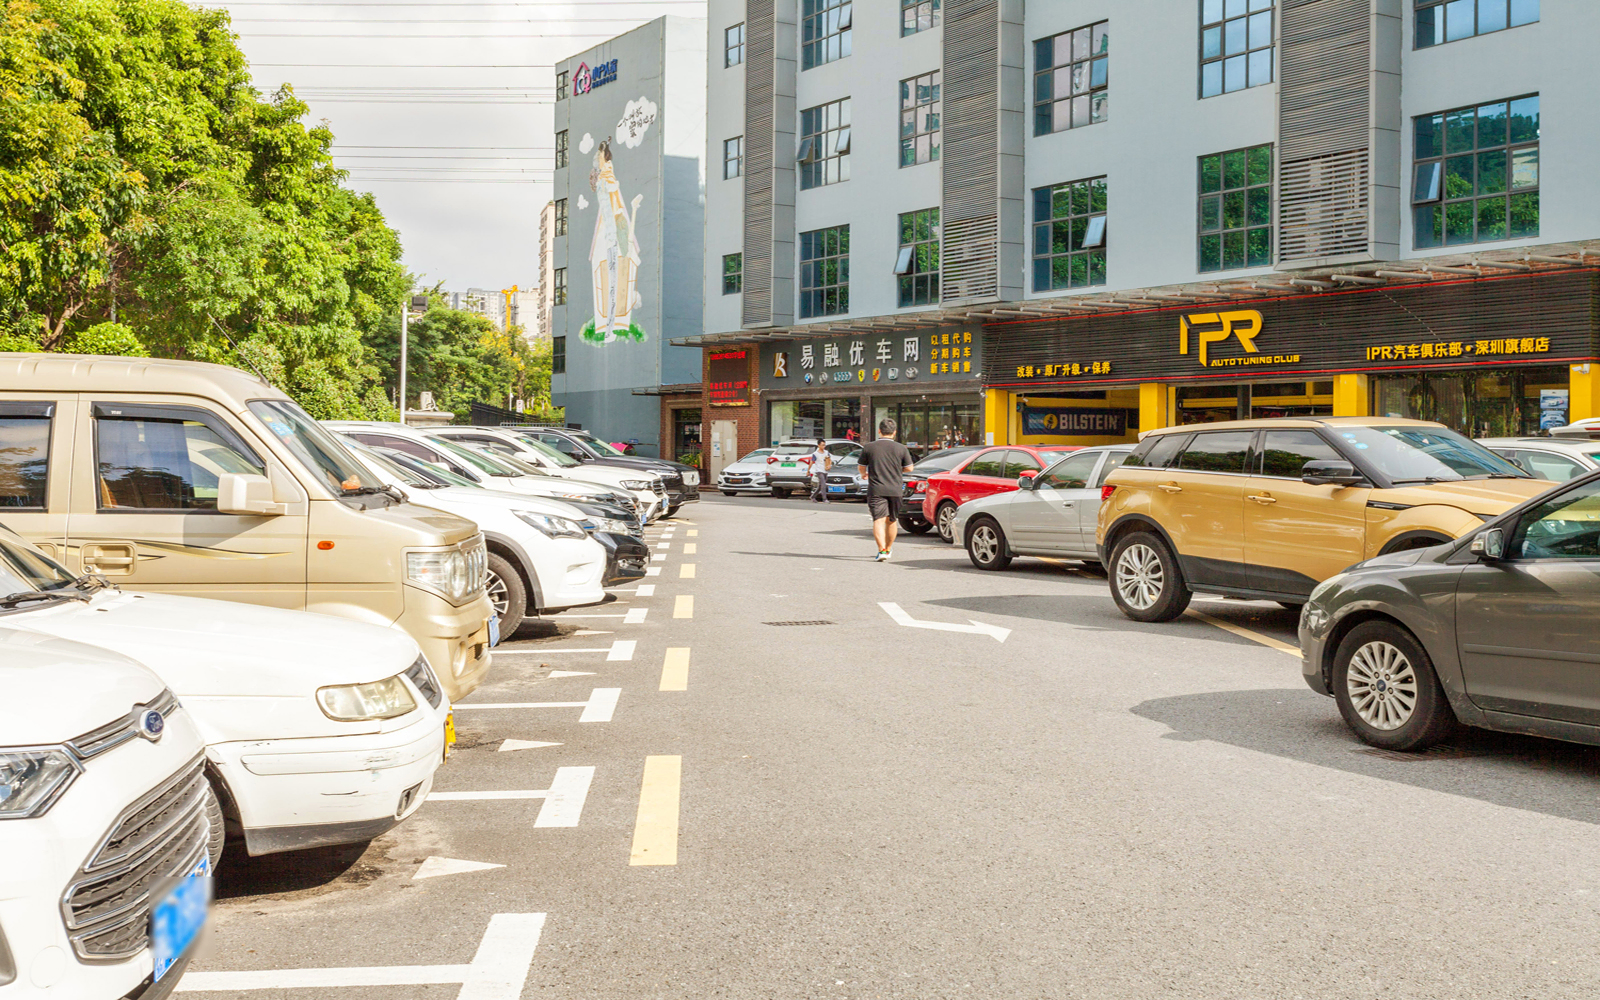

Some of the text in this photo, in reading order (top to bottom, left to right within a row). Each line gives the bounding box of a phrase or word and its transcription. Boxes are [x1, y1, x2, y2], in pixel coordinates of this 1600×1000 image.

[930, 332, 972, 346] 以租代购
[801, 337, 919, 369] 易融优车网
[930, 346, 972, 360] 分期购车
[930, 360, 972, 375] 新车销售
[1210, 355, 1301, 367] AUTO TUNING CLUB
[1059, 413, 1119, 430] BILSTEIN
